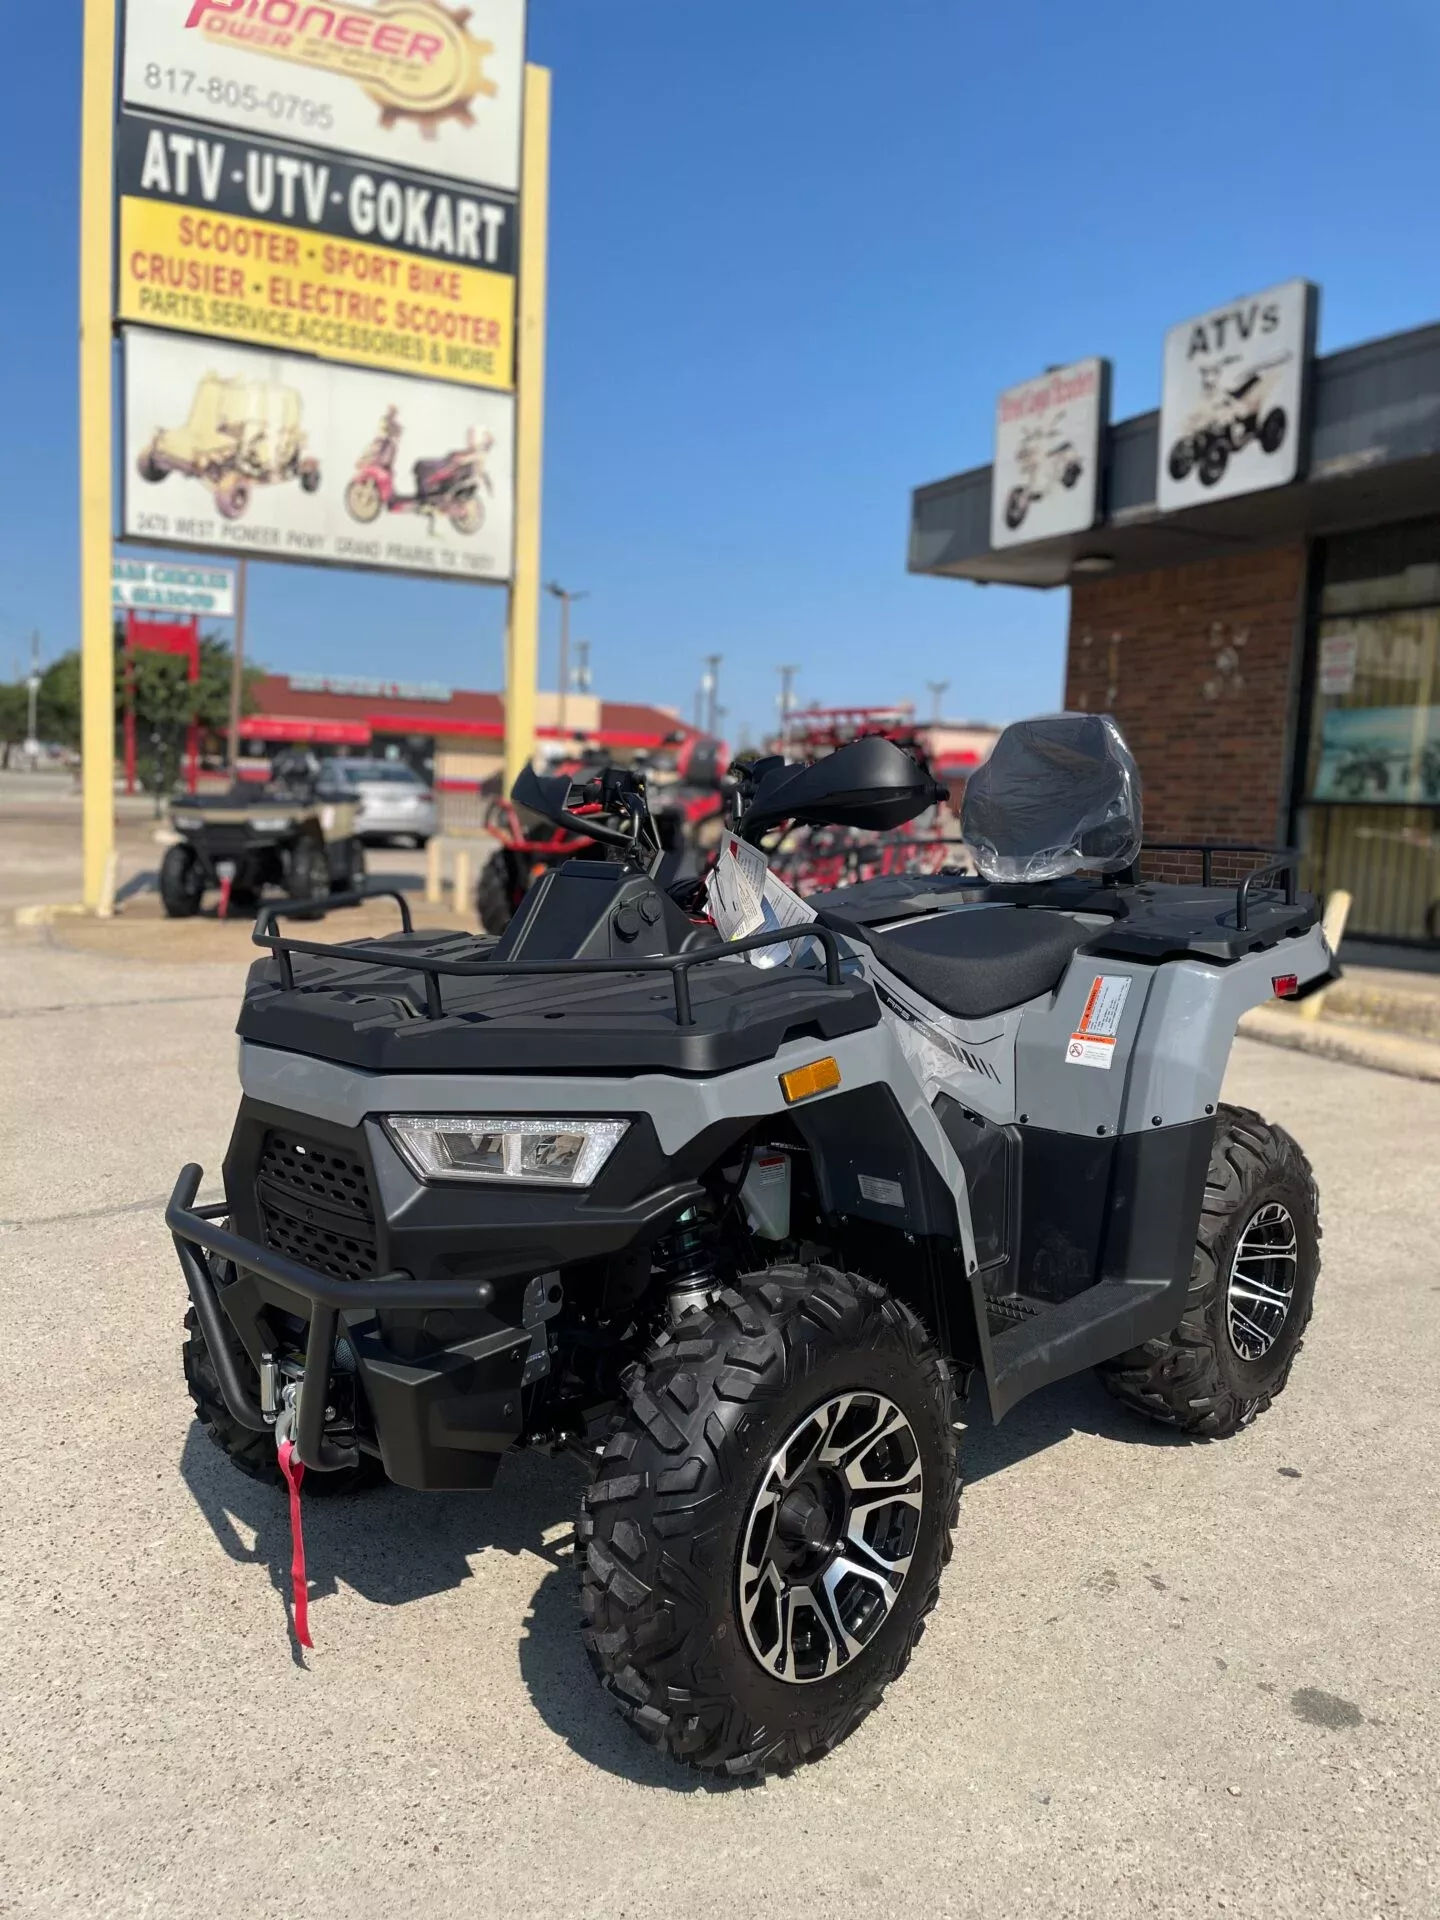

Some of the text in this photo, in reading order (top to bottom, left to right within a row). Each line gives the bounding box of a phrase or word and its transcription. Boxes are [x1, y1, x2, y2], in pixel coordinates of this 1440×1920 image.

[144, 62, 334, 131] 817-805-0795
[141, 129, 505, 263] ATV UTV GOKART
[178, 215, 461, 301] SCOOTER SPORT BIKE
[130, 250, 501, 347] CRUSIER ELECTRIC SCOOTER
[1187, 301, 1280, 362] ATVs
[445, 345, 496, 376] MORE
